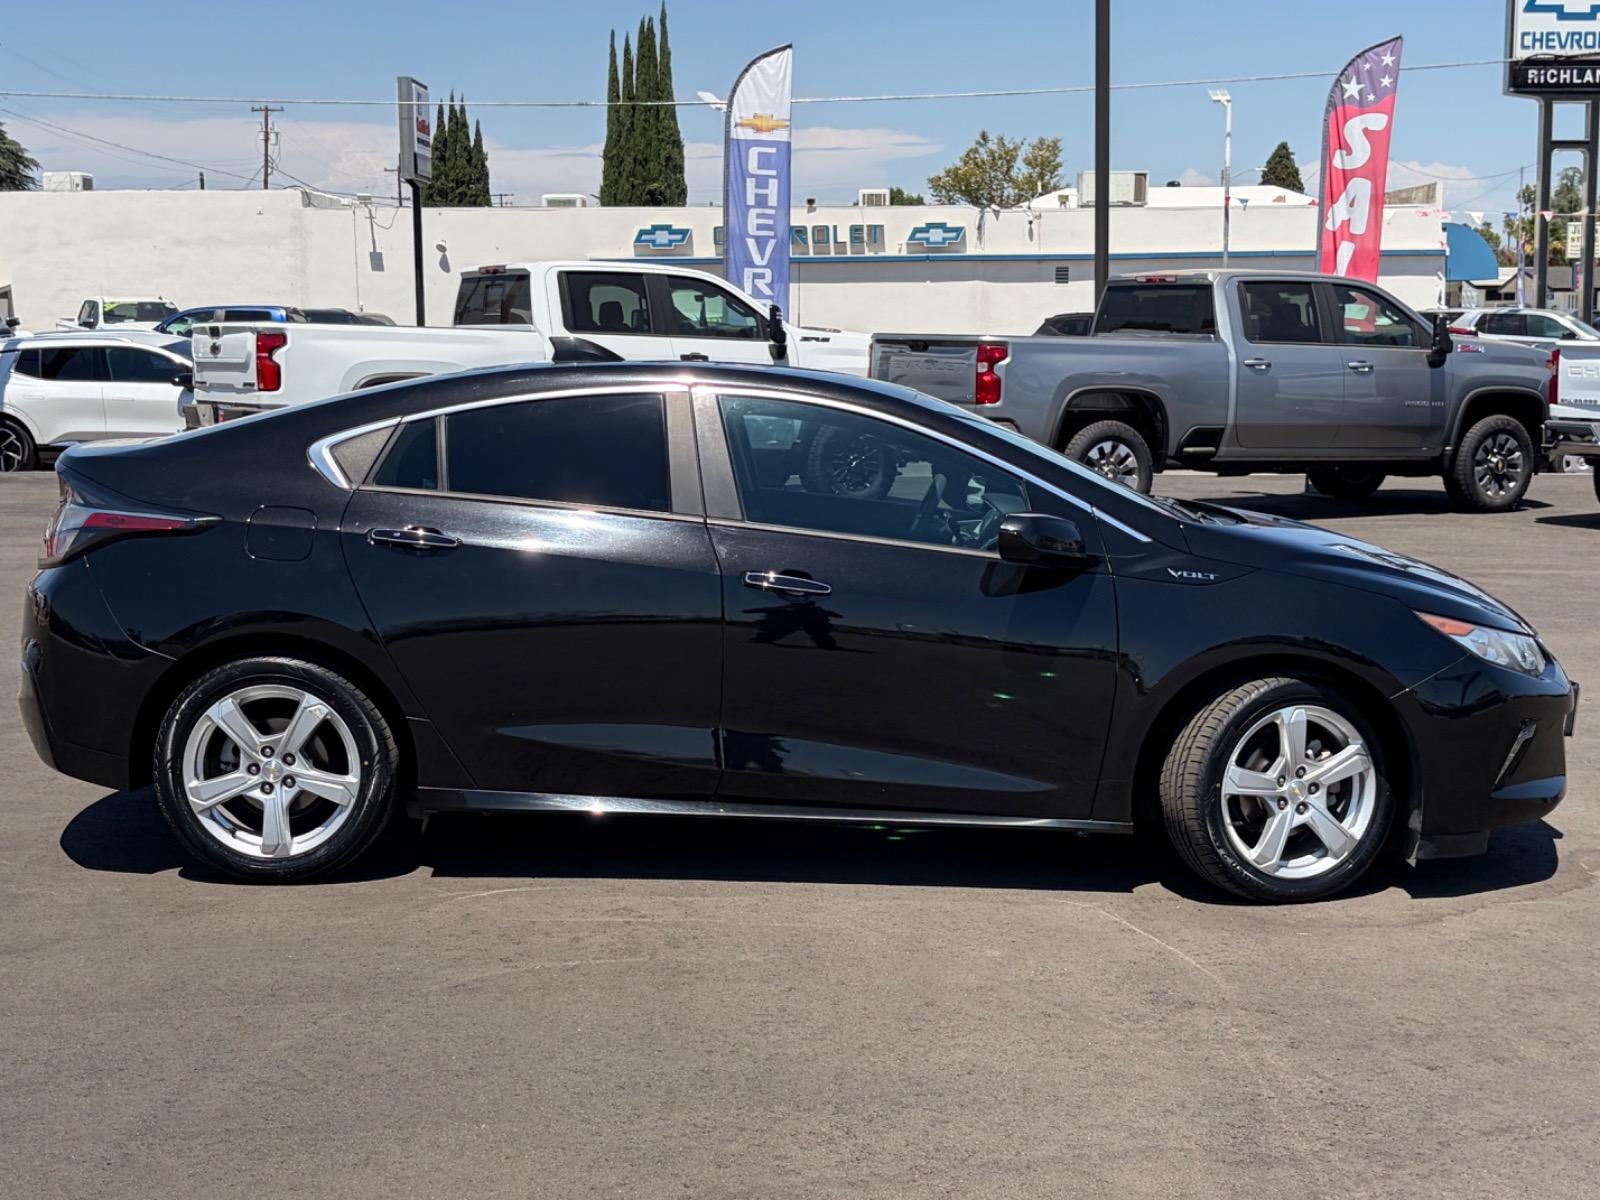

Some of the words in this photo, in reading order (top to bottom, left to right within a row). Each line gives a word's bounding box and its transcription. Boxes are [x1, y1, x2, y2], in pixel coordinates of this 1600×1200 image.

[1520, 31, 1600, 50] CHEVRO
[743, 146, 779, 308] CHEVR
[1167, 567, 1220, 580] VOLT
